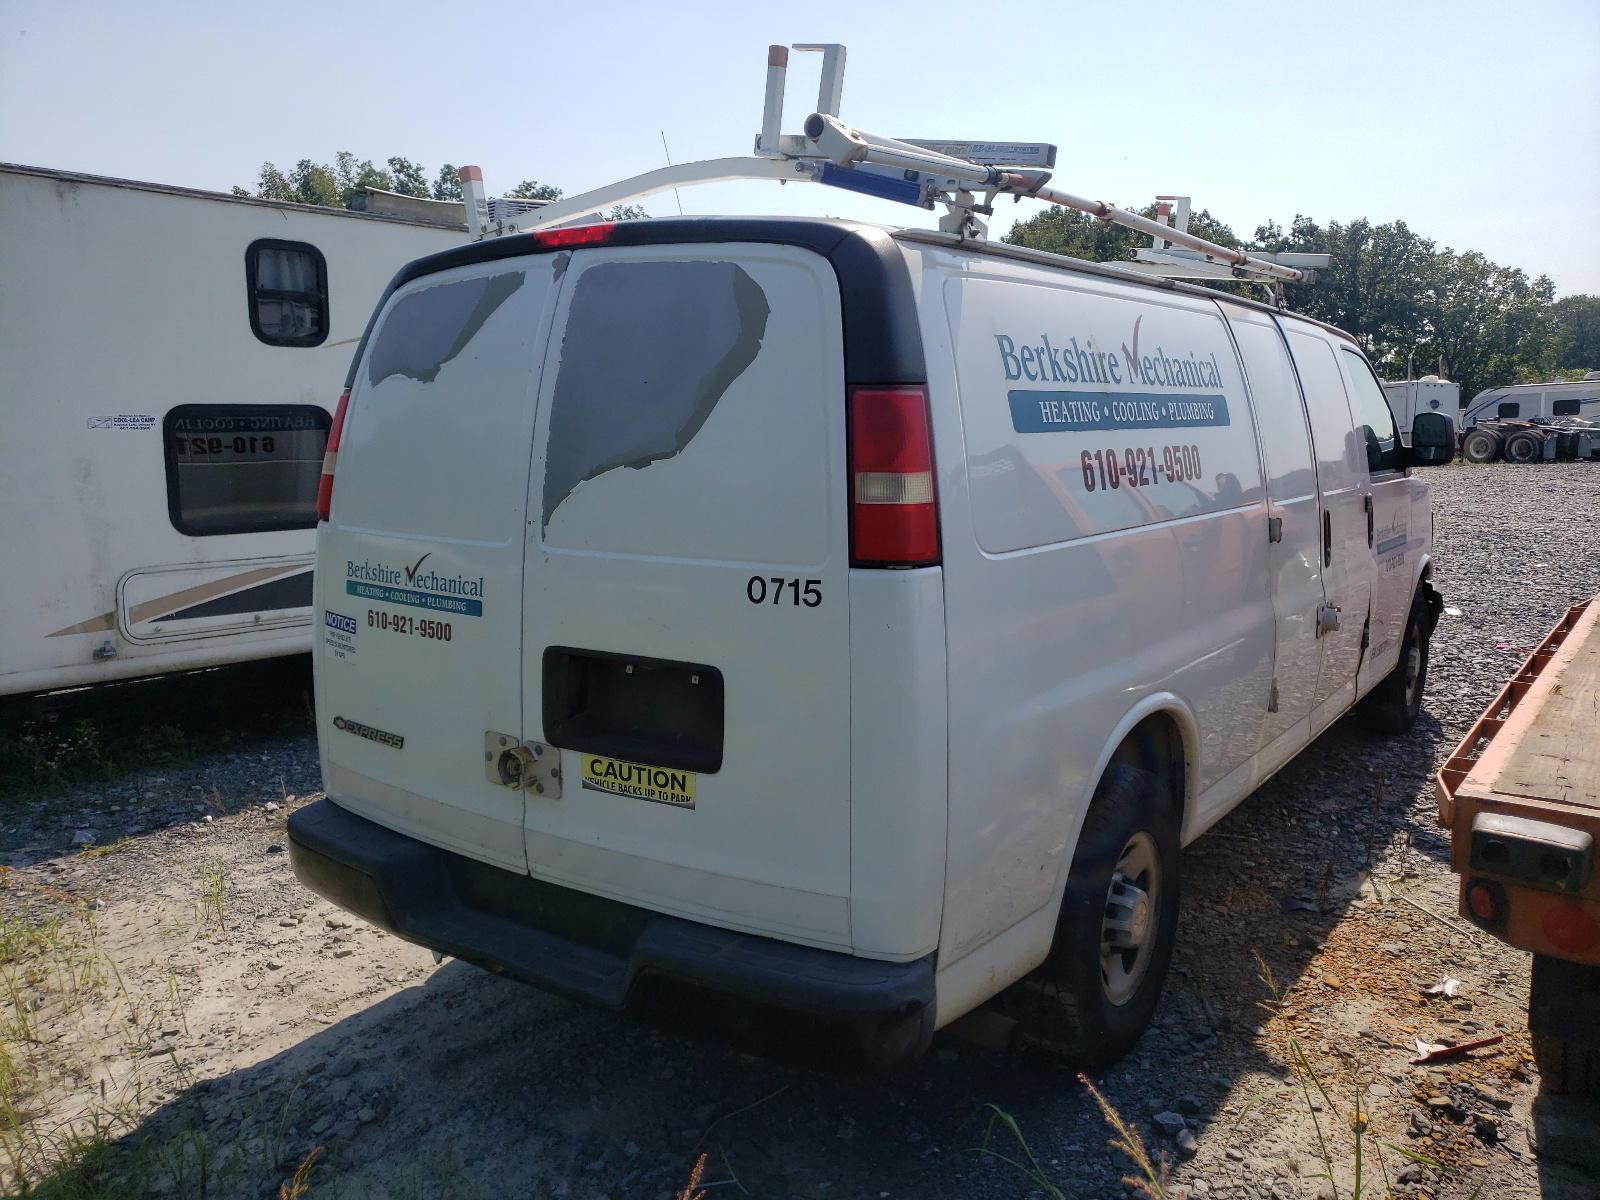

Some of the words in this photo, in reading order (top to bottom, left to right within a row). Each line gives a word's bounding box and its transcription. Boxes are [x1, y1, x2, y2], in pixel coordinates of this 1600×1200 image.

[994, 333, 1122, 385] Berkshire
[1121, 314, 1224, 389] Mechanical
[1039, 401, 1101, 424] HEATING
[1112, 402, 1159, 422] COOLING
[1169, 402, 1214, 421] PLUMBING
[1080, 445, 1201, 492] 610-921-9500
[346, 558, 401, 585] Berkshire
[404, 551, 484, 598] Mechanical
[356, 584, 384, 598] HEATING
[390, 590, 420, 604] COOLING
[427, 597, 467, 611] PLUMBING
[747, 575, 822, 607] 0715
[326, 612, 356, 633] NOTICE
[367, 609, 452, 642] 610-921-9500
[590, 758, 687, 792] CAUTION
[618, 783, 643, 796] BACKS
[644, 788, 656, 798] UP
[657, 790, 669, 801] TO
